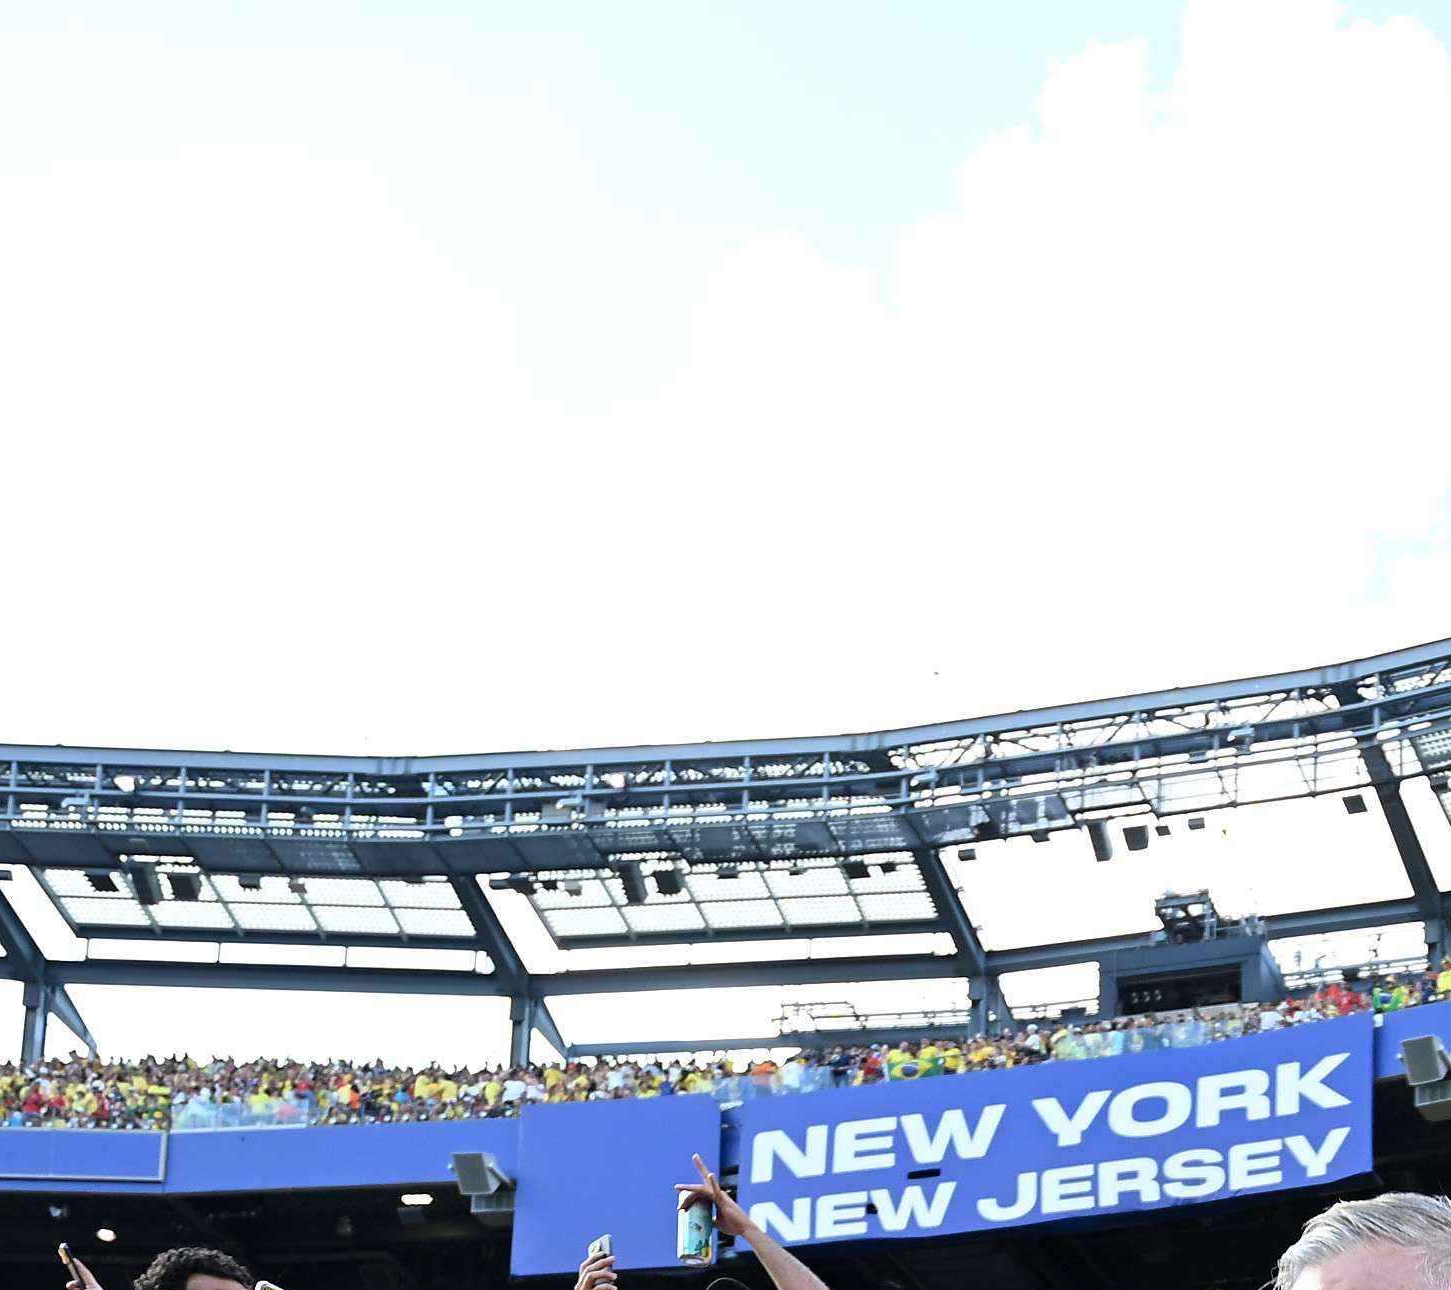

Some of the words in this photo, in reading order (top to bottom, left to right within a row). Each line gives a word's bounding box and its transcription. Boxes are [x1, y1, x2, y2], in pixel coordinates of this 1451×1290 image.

[751, 1104, 1006, 1183] NEW
[1032, 1052, 1352, 1148] YORK
[748, 1181, 956, 1242] NEW
[977, 1127, 1352, 1222] JERSEY
